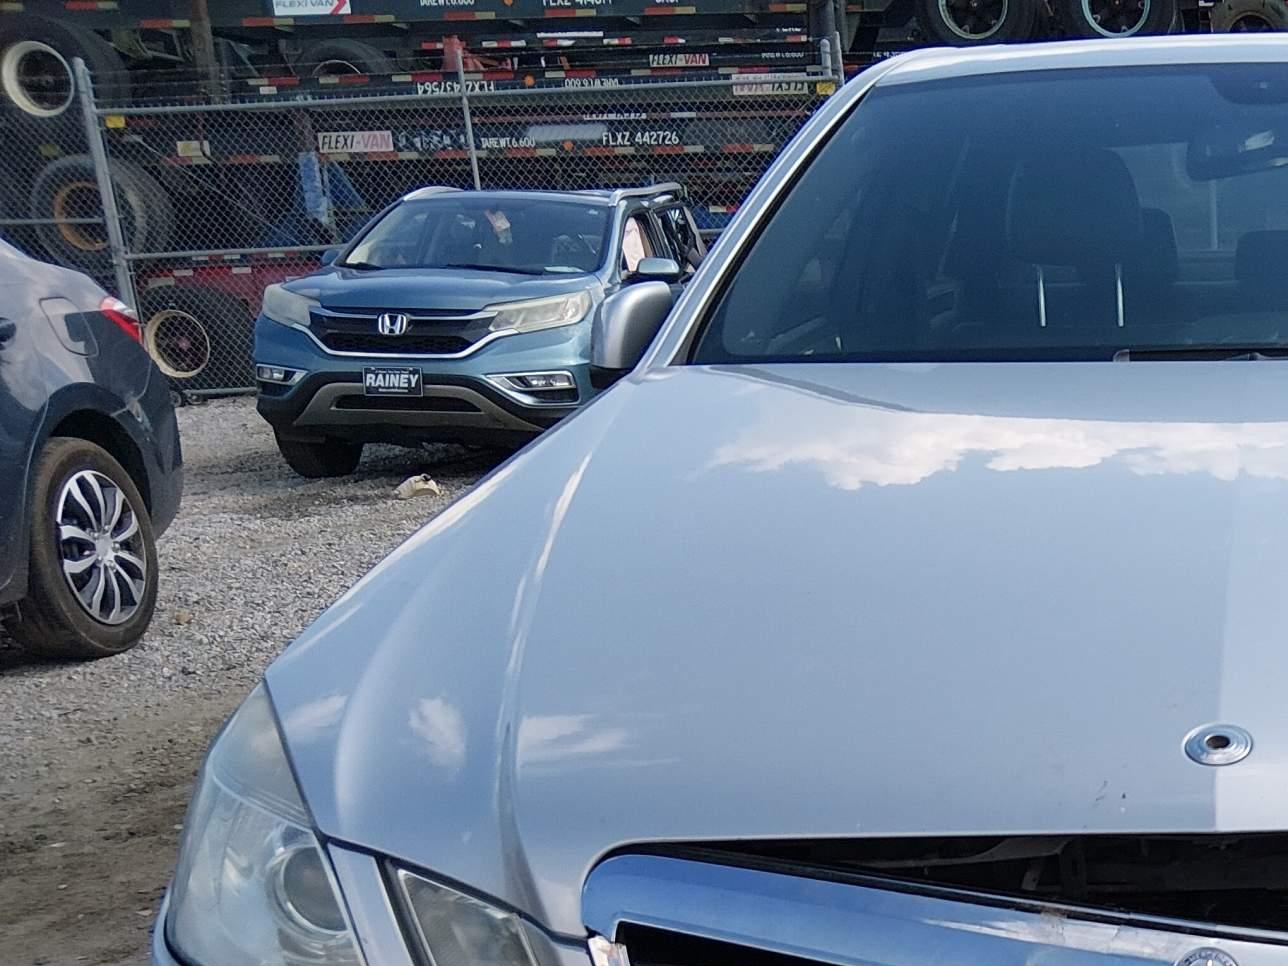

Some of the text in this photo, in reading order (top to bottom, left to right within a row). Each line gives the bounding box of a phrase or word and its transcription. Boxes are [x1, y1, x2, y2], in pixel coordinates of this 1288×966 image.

[416, 81, 462, 95] 437564
[602, 131, 680, 145] FLXZ 442726
[365, 373, 420, 388] RAINEY
